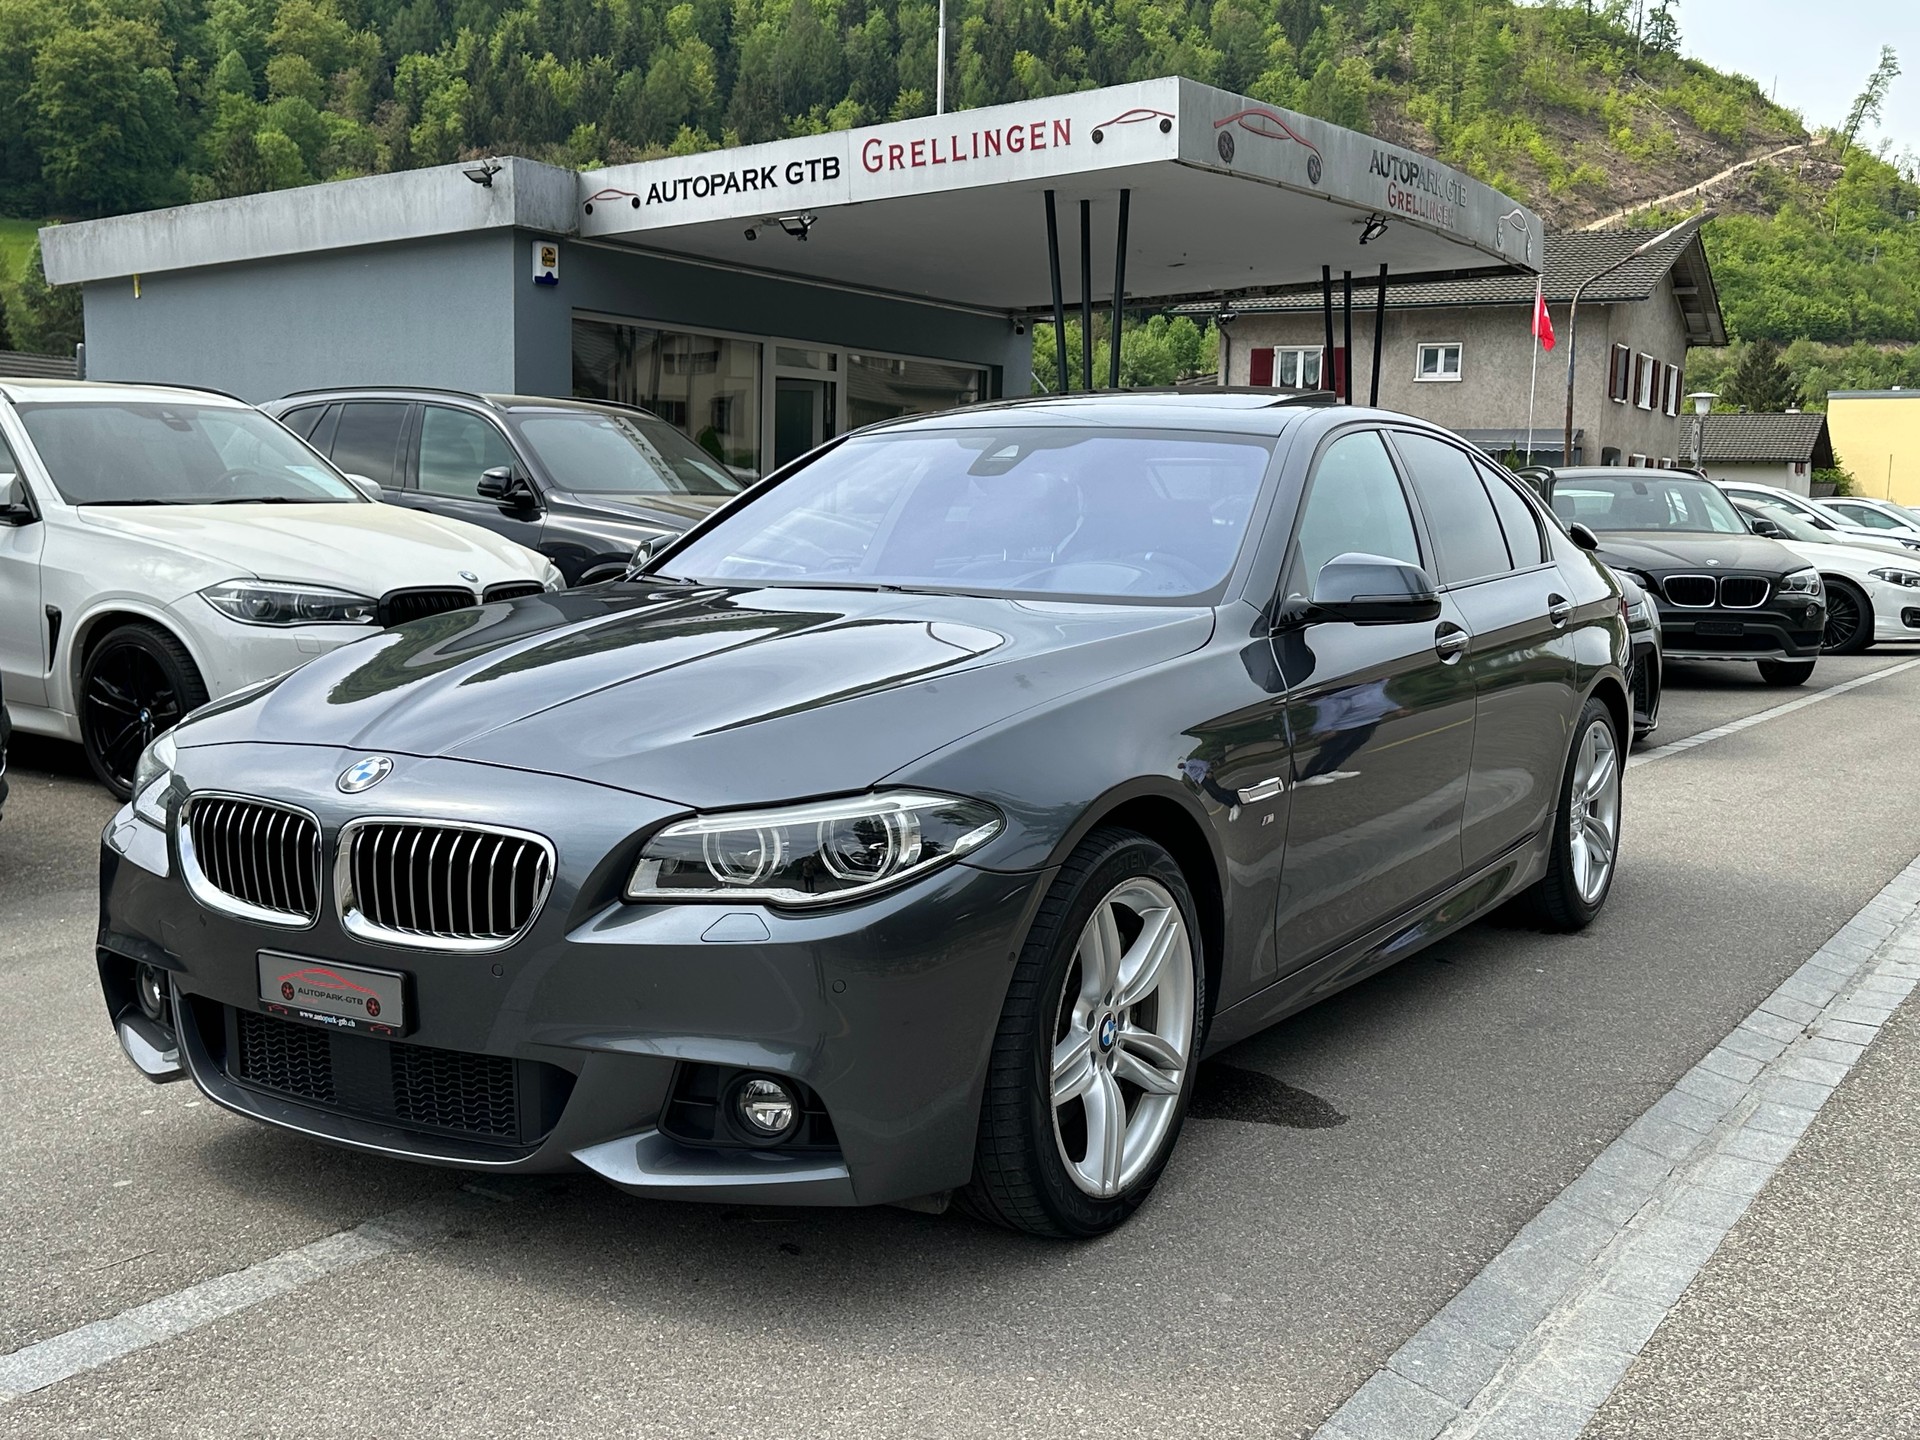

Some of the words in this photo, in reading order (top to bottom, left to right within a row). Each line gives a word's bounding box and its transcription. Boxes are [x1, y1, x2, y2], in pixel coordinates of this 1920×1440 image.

[862, 118, 1071, 173] GRELLINGEN
[646, 165, 778, 205] AUTOPARK
[785, 156, 840, 185] GTB
[1369, 149, 1443, 198] AUTOPARK
[1445, 178, 1468, 208] GTB
[298, 987, 363, 1005] AUTOPARK-GTB
